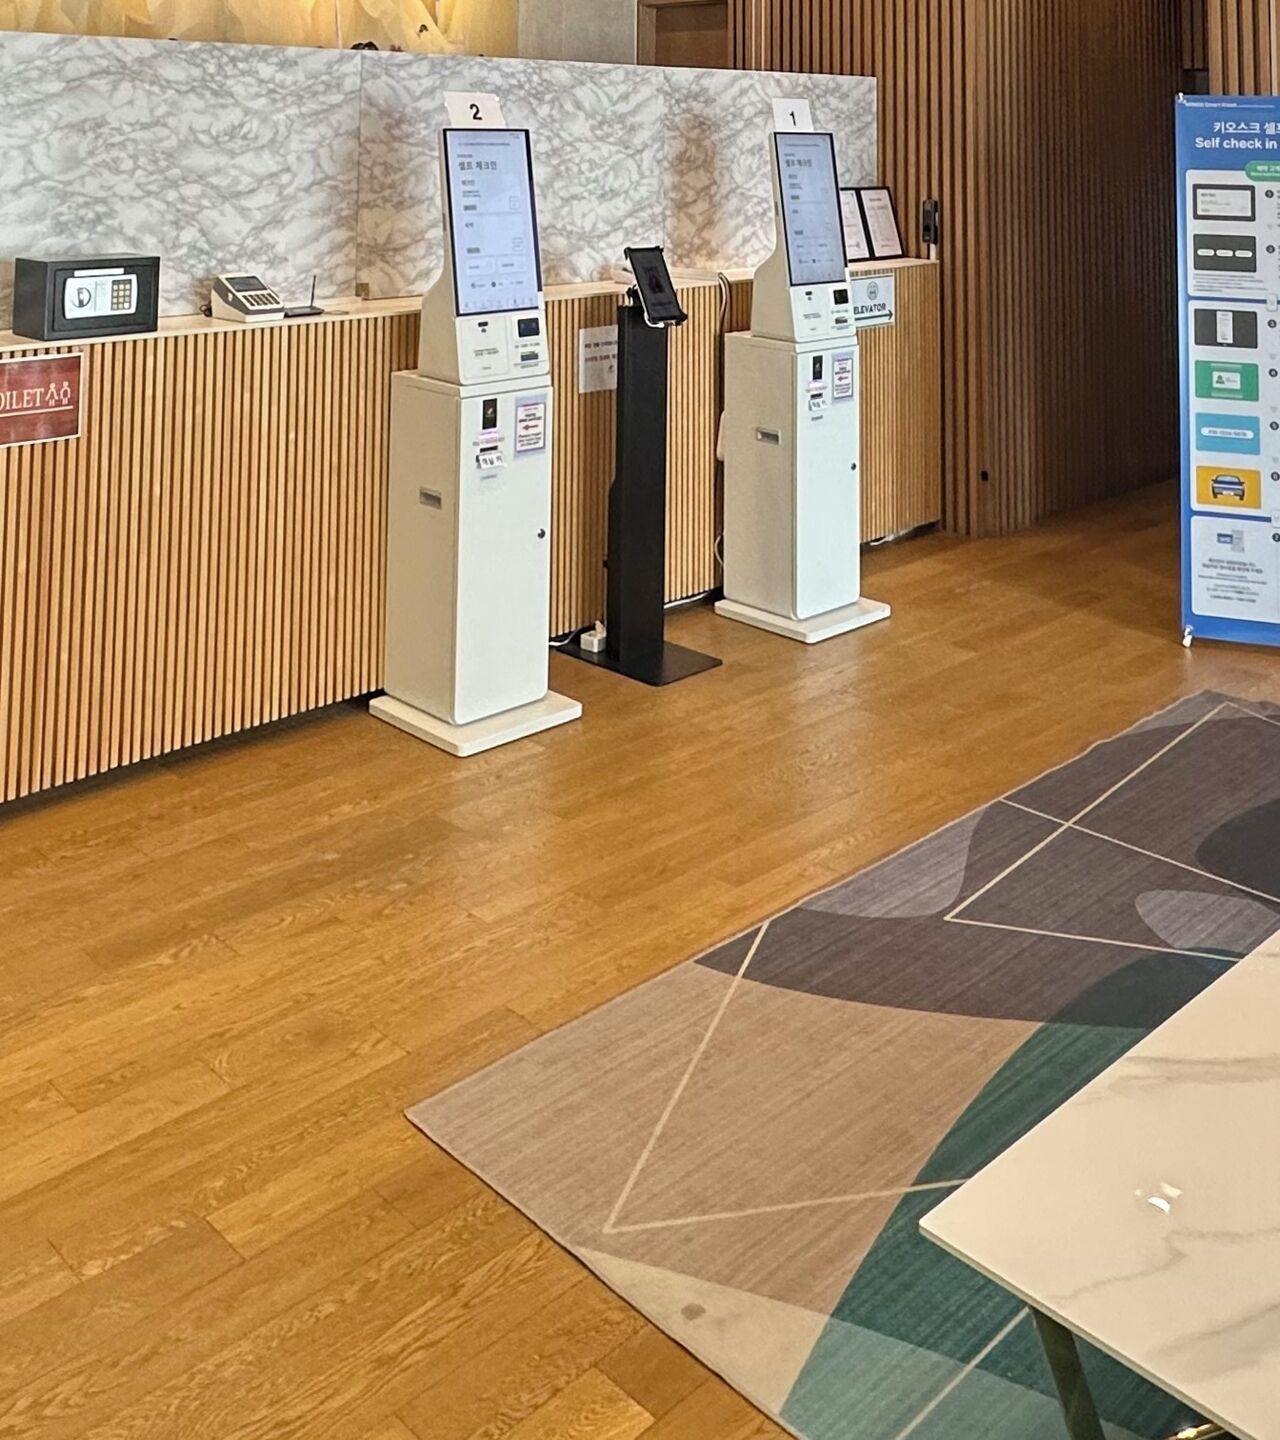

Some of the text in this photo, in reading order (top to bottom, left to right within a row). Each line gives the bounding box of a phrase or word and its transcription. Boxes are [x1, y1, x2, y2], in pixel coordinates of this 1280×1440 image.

[469, 103, 483, 120] 2
[789, 111, 797, 126] 1
[1213, 121, 1261, 134] 키오스크
[1195, 137, 1221, 148] Self
[1223, 139, 1263, 149] check
[1266, 140, 1277, 149] in
[853, 303, 886, 315] ELEVATOR
